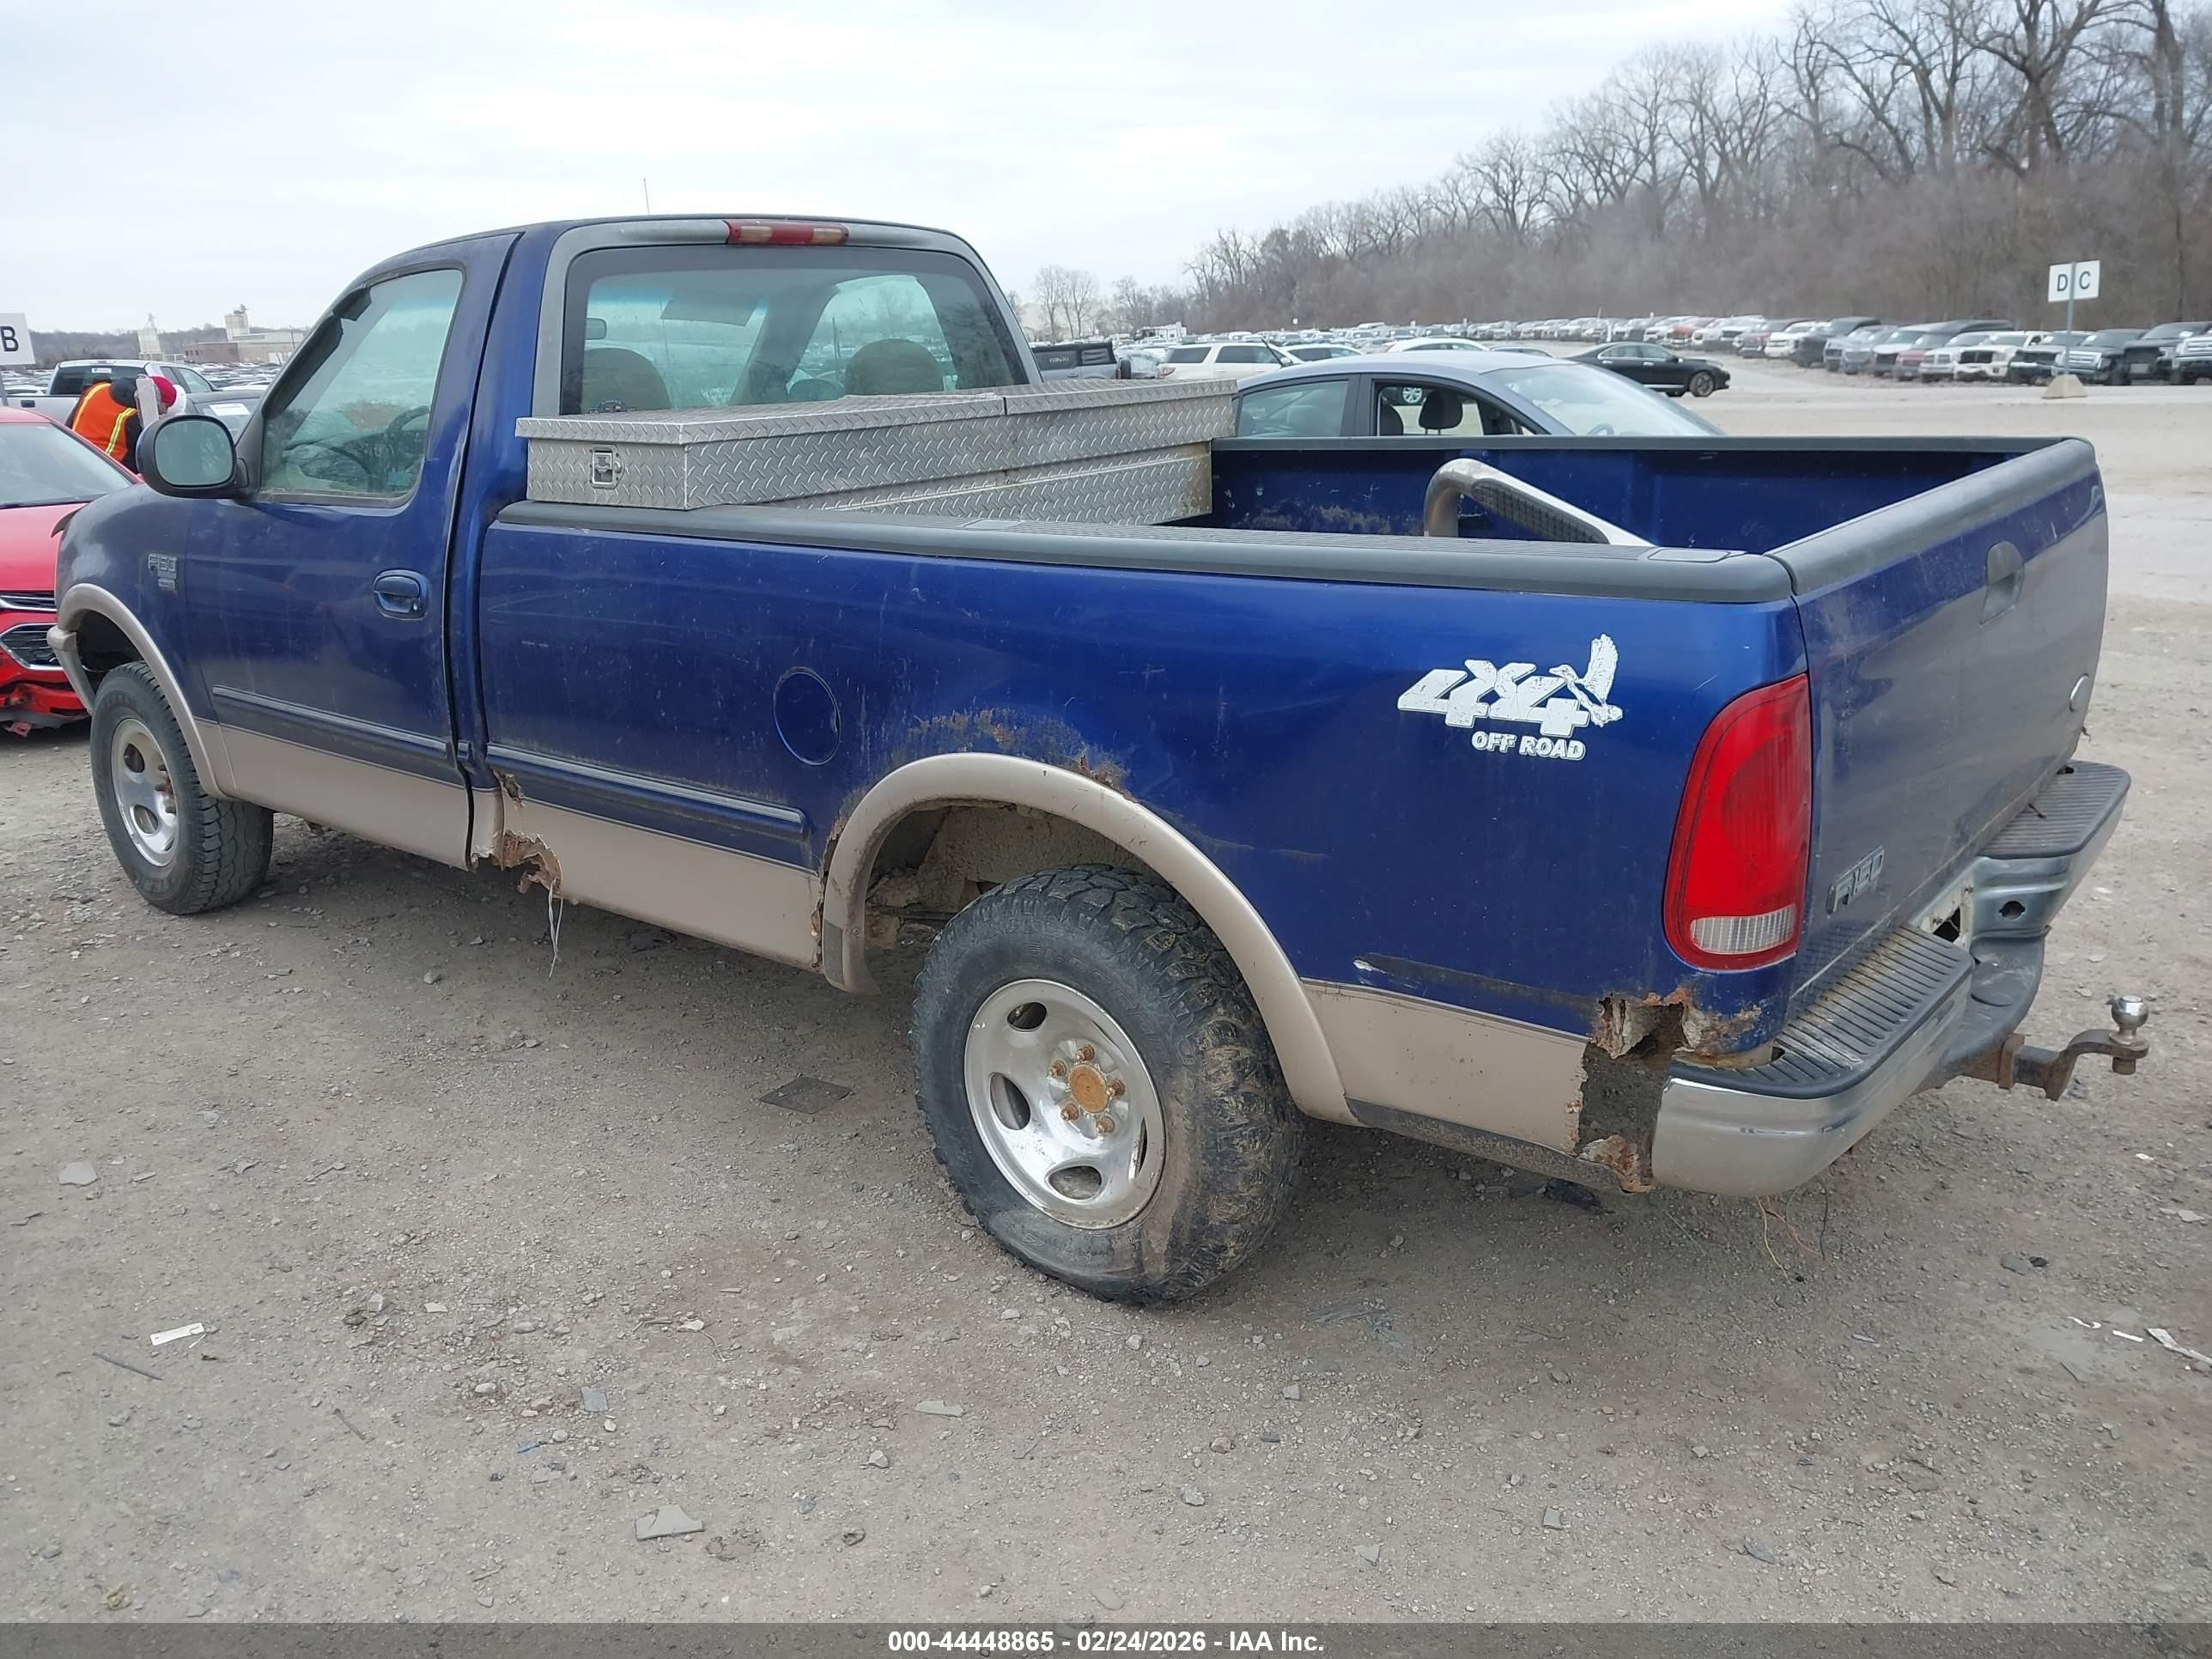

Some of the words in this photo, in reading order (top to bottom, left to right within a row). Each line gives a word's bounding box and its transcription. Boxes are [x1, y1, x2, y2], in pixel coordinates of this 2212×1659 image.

[2057, 274, 2069, 292] D
[2079, 270, 2091, 290] C
[0, 325, 19, 352] B
[1471, 731, 1516, 752] OFF
[1519, 736, 1586, 760] ROAD
